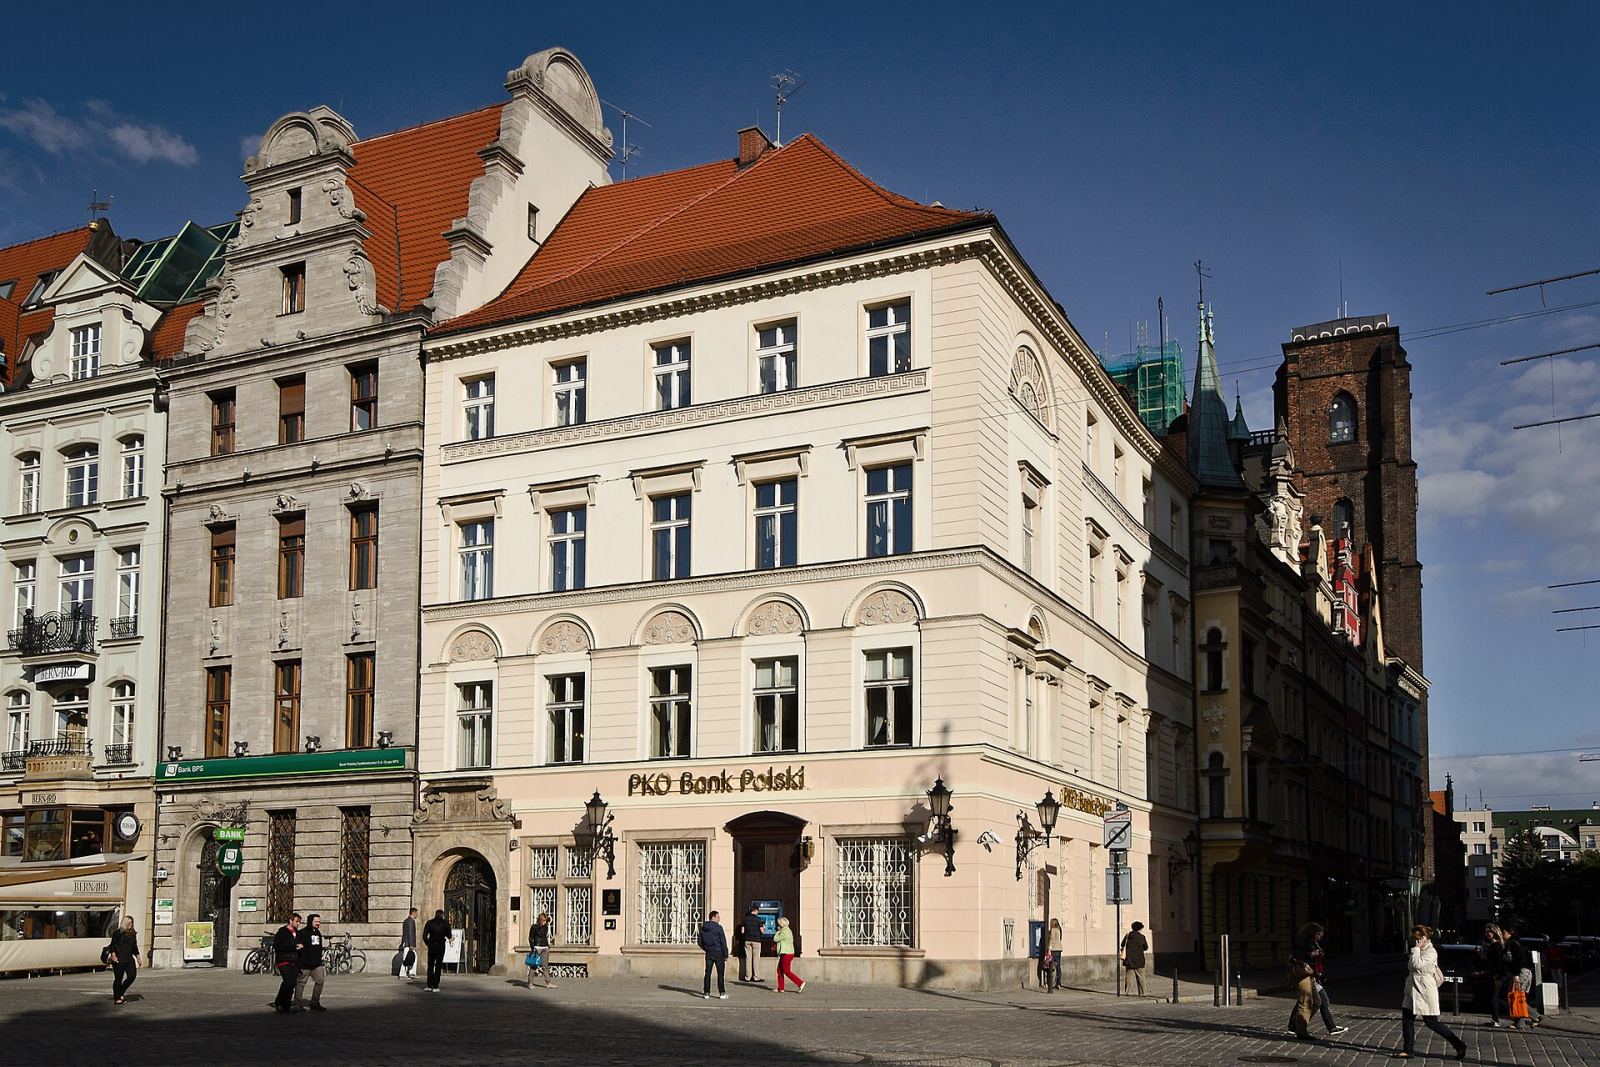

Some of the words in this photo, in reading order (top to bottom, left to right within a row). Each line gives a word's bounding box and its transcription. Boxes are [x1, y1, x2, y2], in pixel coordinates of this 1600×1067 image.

[192, 765, 204, 773] BPS
[628, 773, 672, 797] PKO
[680, 768, 733, 795] Bank
[739, 765, 805, 793] Polski
[220, 830, 242, 839] BANK
[74, 882, 109, 892] BERNARD
